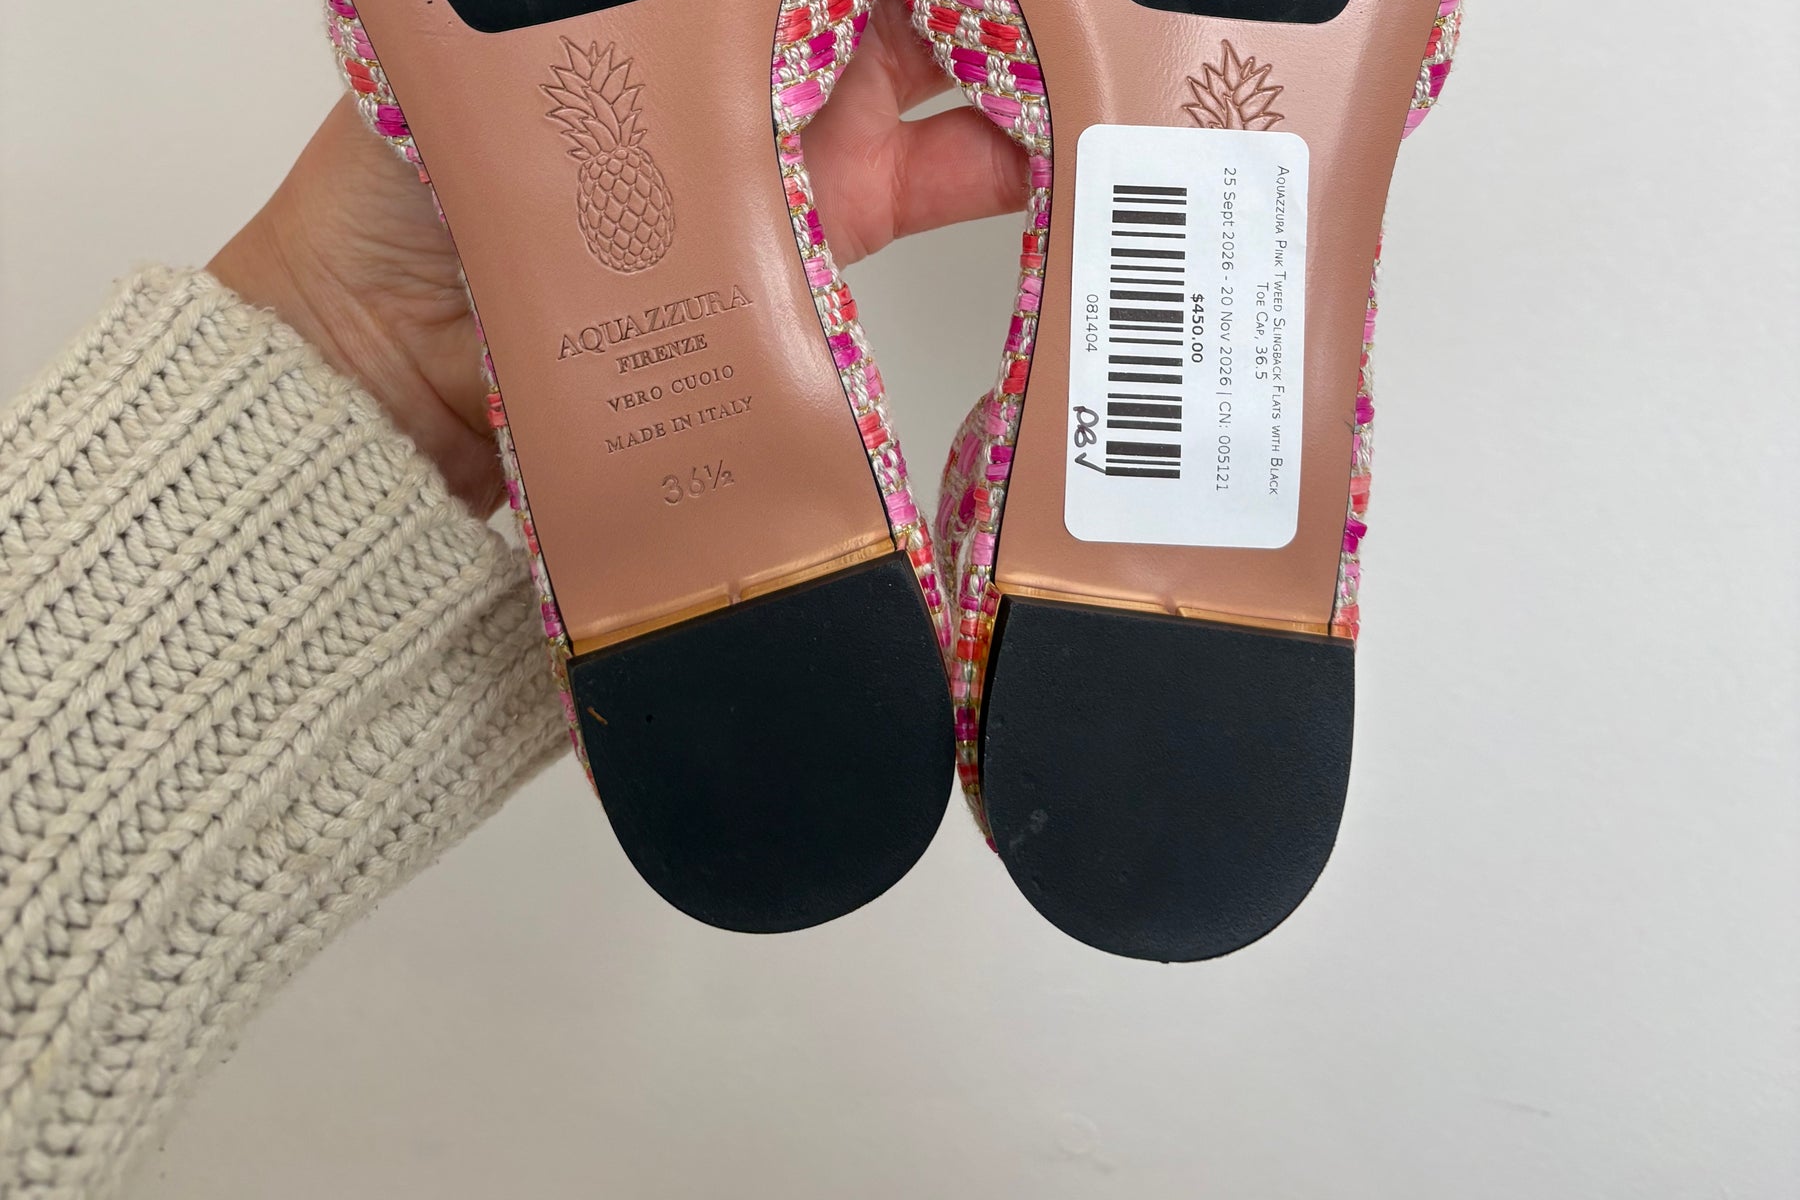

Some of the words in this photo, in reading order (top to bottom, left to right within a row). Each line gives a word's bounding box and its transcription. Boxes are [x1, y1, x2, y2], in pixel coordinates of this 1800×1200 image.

[1223, 167, 1237, 186] 25
[1220, 191, 1236, 227] Sept
[1221, 231, 1235, 271] 2026
[1220, 286, 1234, 306] 20
[557, 284, 752, 360] AQUAZZURA
[1085, 294, 1099, 353] 081404
[1190, 293, 1205, 363] $450.00
[1219, 311, 1233, 341] Nov
[616, 333, 708, 374] FIRENZE
[1219, 346, 1233, 386] 2026
[1255, 346, 1268, 380] 36.5
[607, 386, 663, 412] VERO
[671, 365, 734, 394] CUOIO
[605, 422, 666, 453] MADE
[672, 414, 693, 432] IN
[699, 396, 752, 424] ITALY
[1218, 401, 1232, 428] CN:
[1216, 435, 1231, 491] 005121
